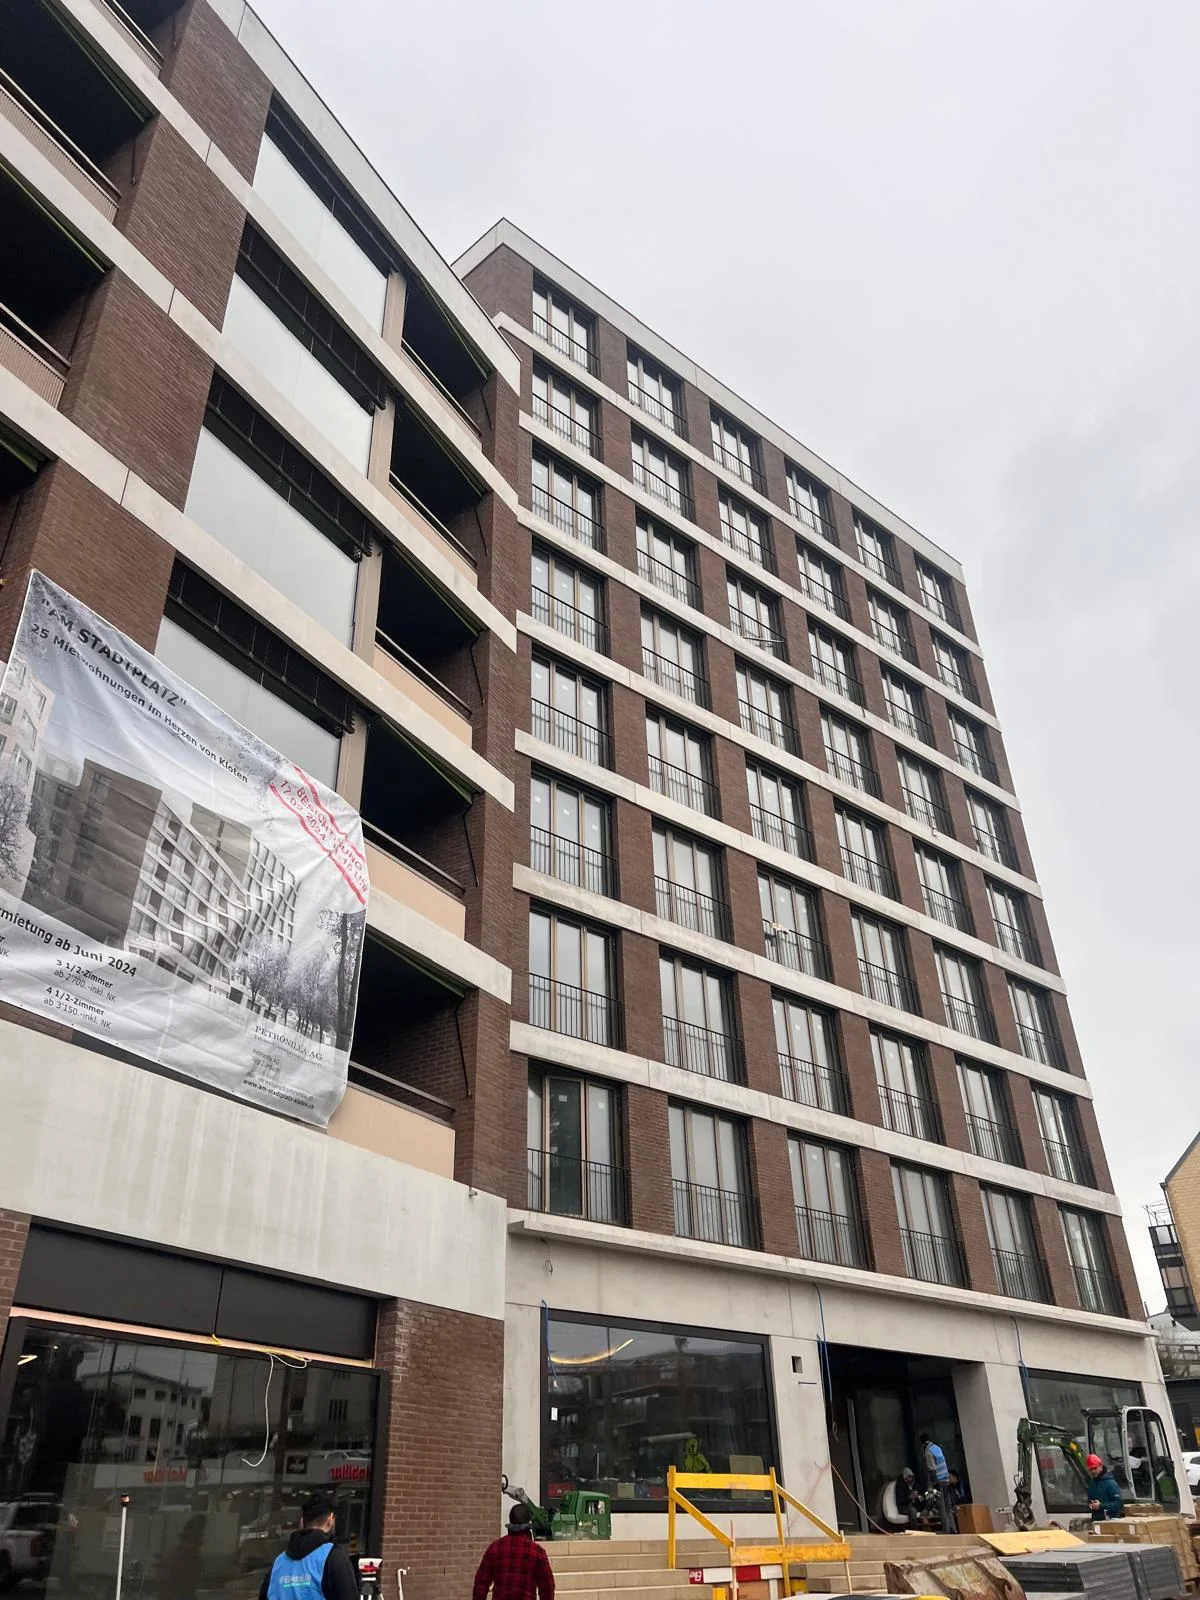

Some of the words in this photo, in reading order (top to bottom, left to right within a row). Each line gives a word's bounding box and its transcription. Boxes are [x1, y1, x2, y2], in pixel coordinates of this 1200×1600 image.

[32, 623, 50, 639] 25
[148, 702, 162, 718] im
[164, 715, 197, 746] Herzen
[200, 744, 217, 760] von
[219, 757, 248, 783] Kloten
[0, 907, 53, 944] mietung
[55, 938, 71, 951] ab
[73, 945, 103, 962] Juni
[107, 956, 137, 977] 2024
[54, 969, 64, 978] ab
[46, 986, 53, 995] 4
[43, 997, 54, 1006] ab
[100, 1019, 112, 1030] NK
[308, 1050, 323, 1061] AG
